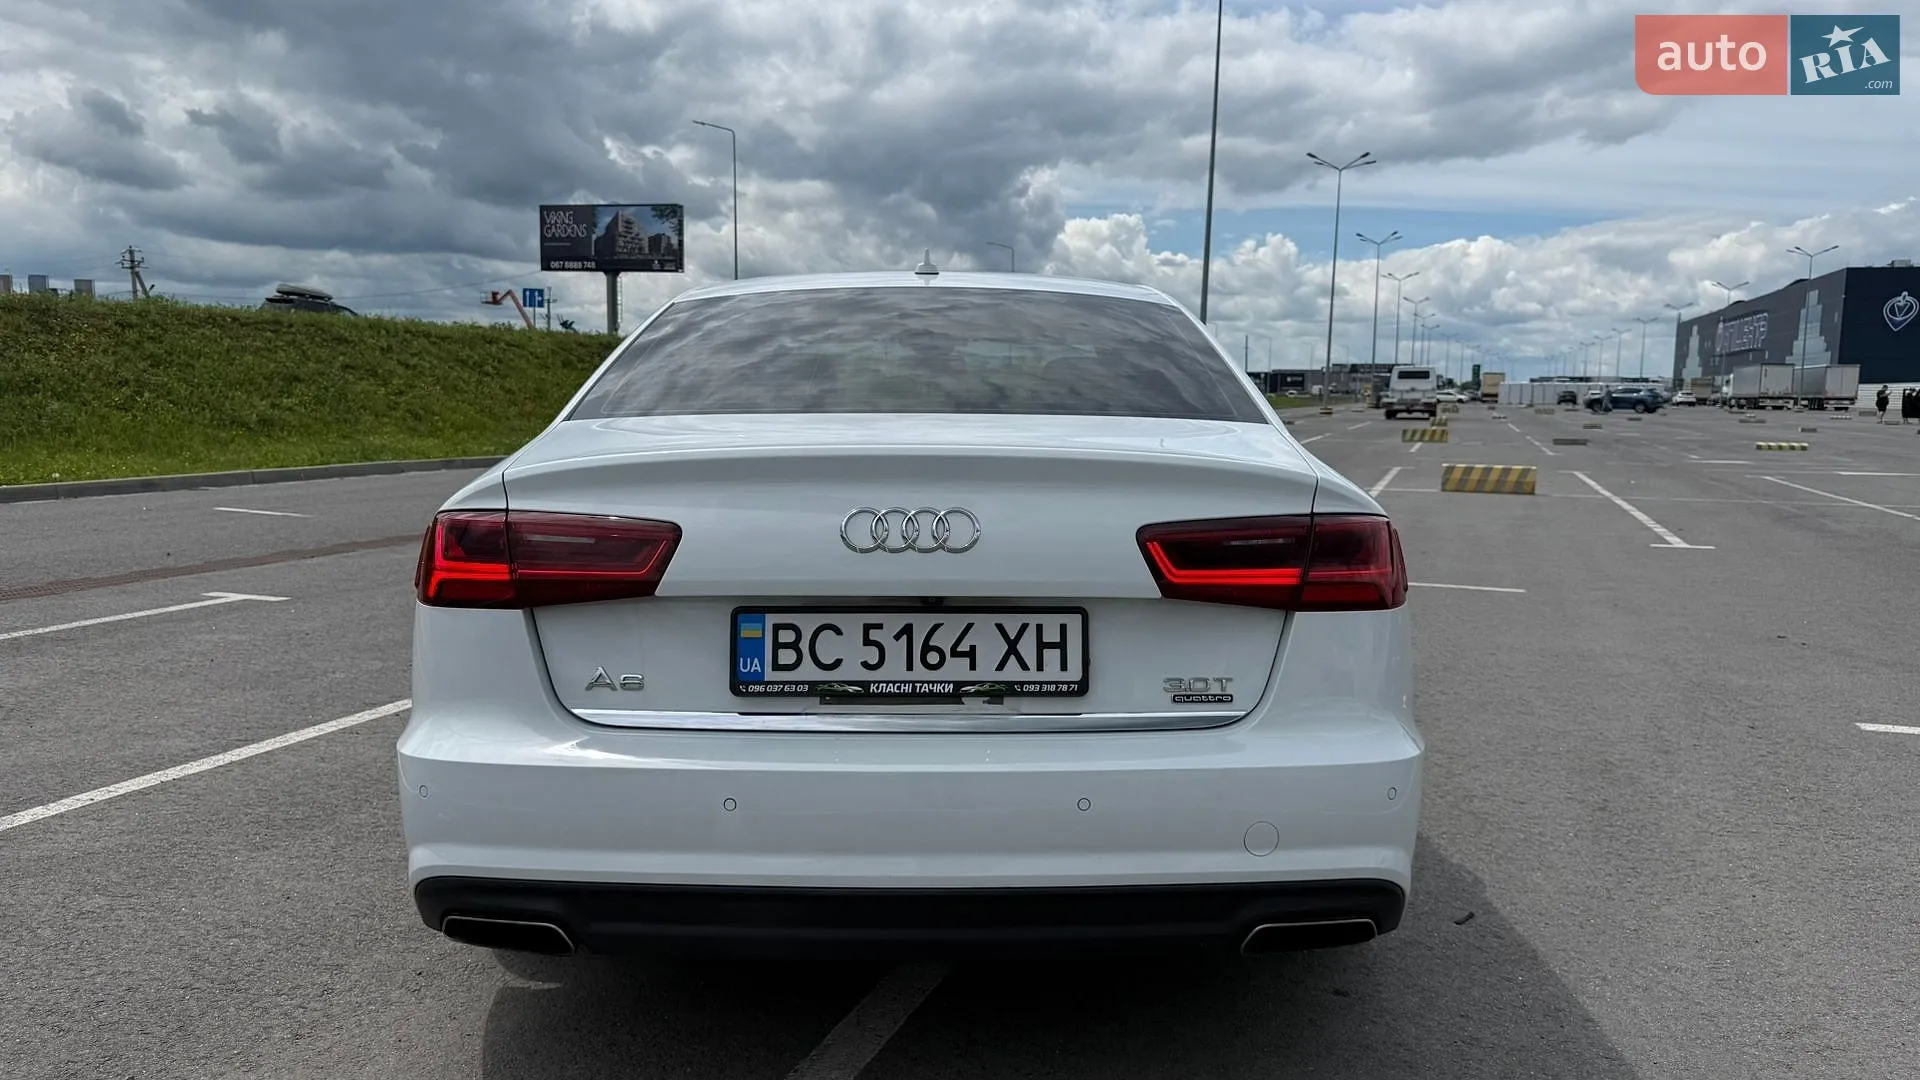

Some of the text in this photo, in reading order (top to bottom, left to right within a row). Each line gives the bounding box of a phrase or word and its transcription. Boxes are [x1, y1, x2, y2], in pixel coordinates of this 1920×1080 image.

[543, 210, 574, 224] VIKING
[543, 223, 588, 238] GARDENS
[771, 622, 1068, 672] BC 5164 XH
[739, 657, 761, 673] UA
[585, 666, 645, 691] A6
[748, 684, 809, 692] 096 037 63 03
[869, 683, 954, 693] КЛАСНІ ТАЧКИ
[1023, 684, 1078, 692] 093 318 78 71
